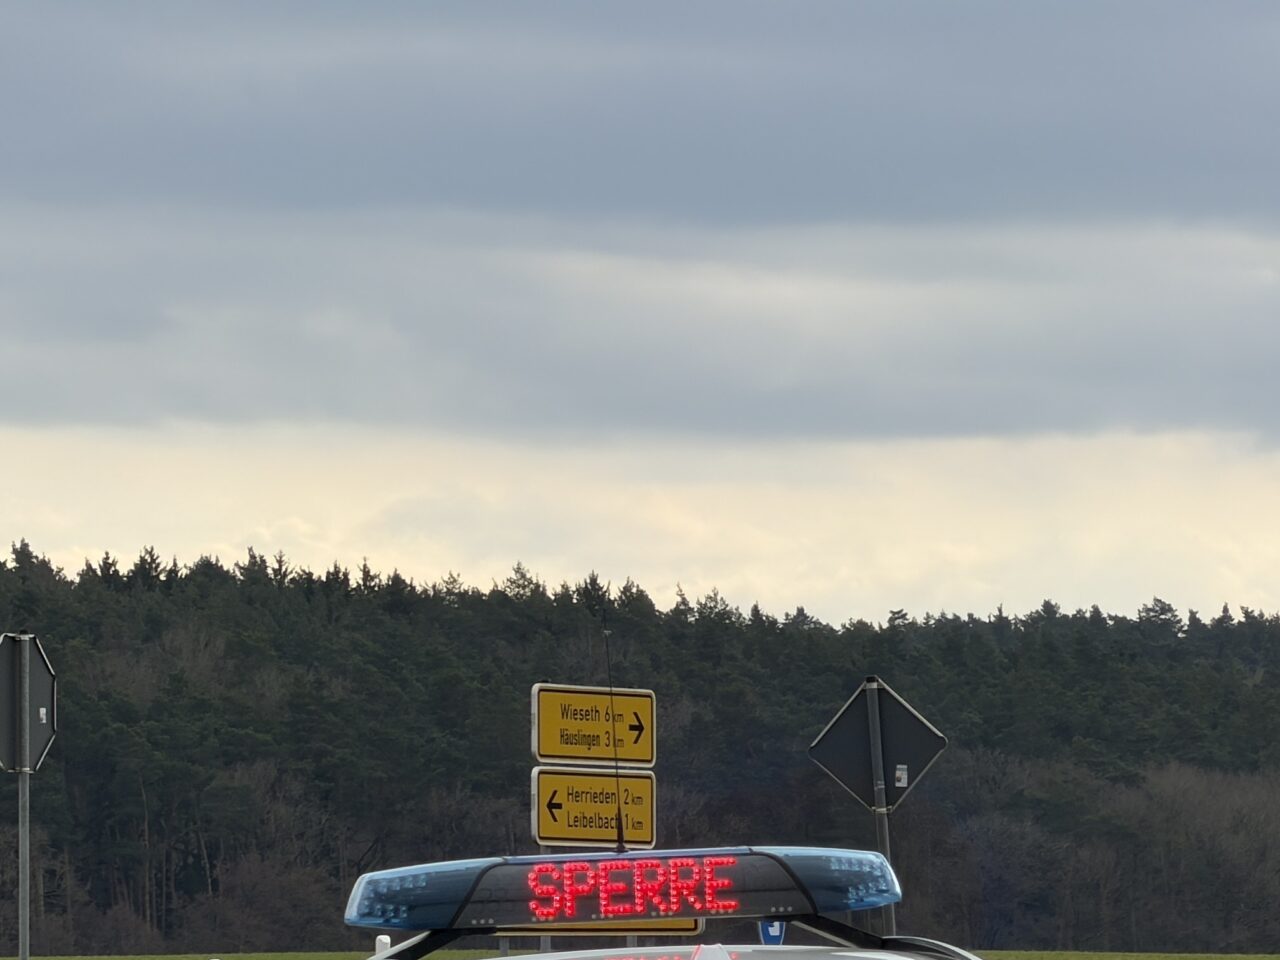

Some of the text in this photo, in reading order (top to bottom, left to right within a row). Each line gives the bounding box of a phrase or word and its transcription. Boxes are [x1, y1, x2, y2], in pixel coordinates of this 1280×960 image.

[560, 703, 600, 722] Wieseth
[604, 705, 610, 722] 6
[560, 728, 600, 750] Häuslingen
[604, 730, 610, 747] 3
[567, 786, 644, 805] Herrieden 2 km
[624, 813, 629, 830] 1
[632, 818, 644, 830] km
[527, 856, 738, 919] SPERRE
